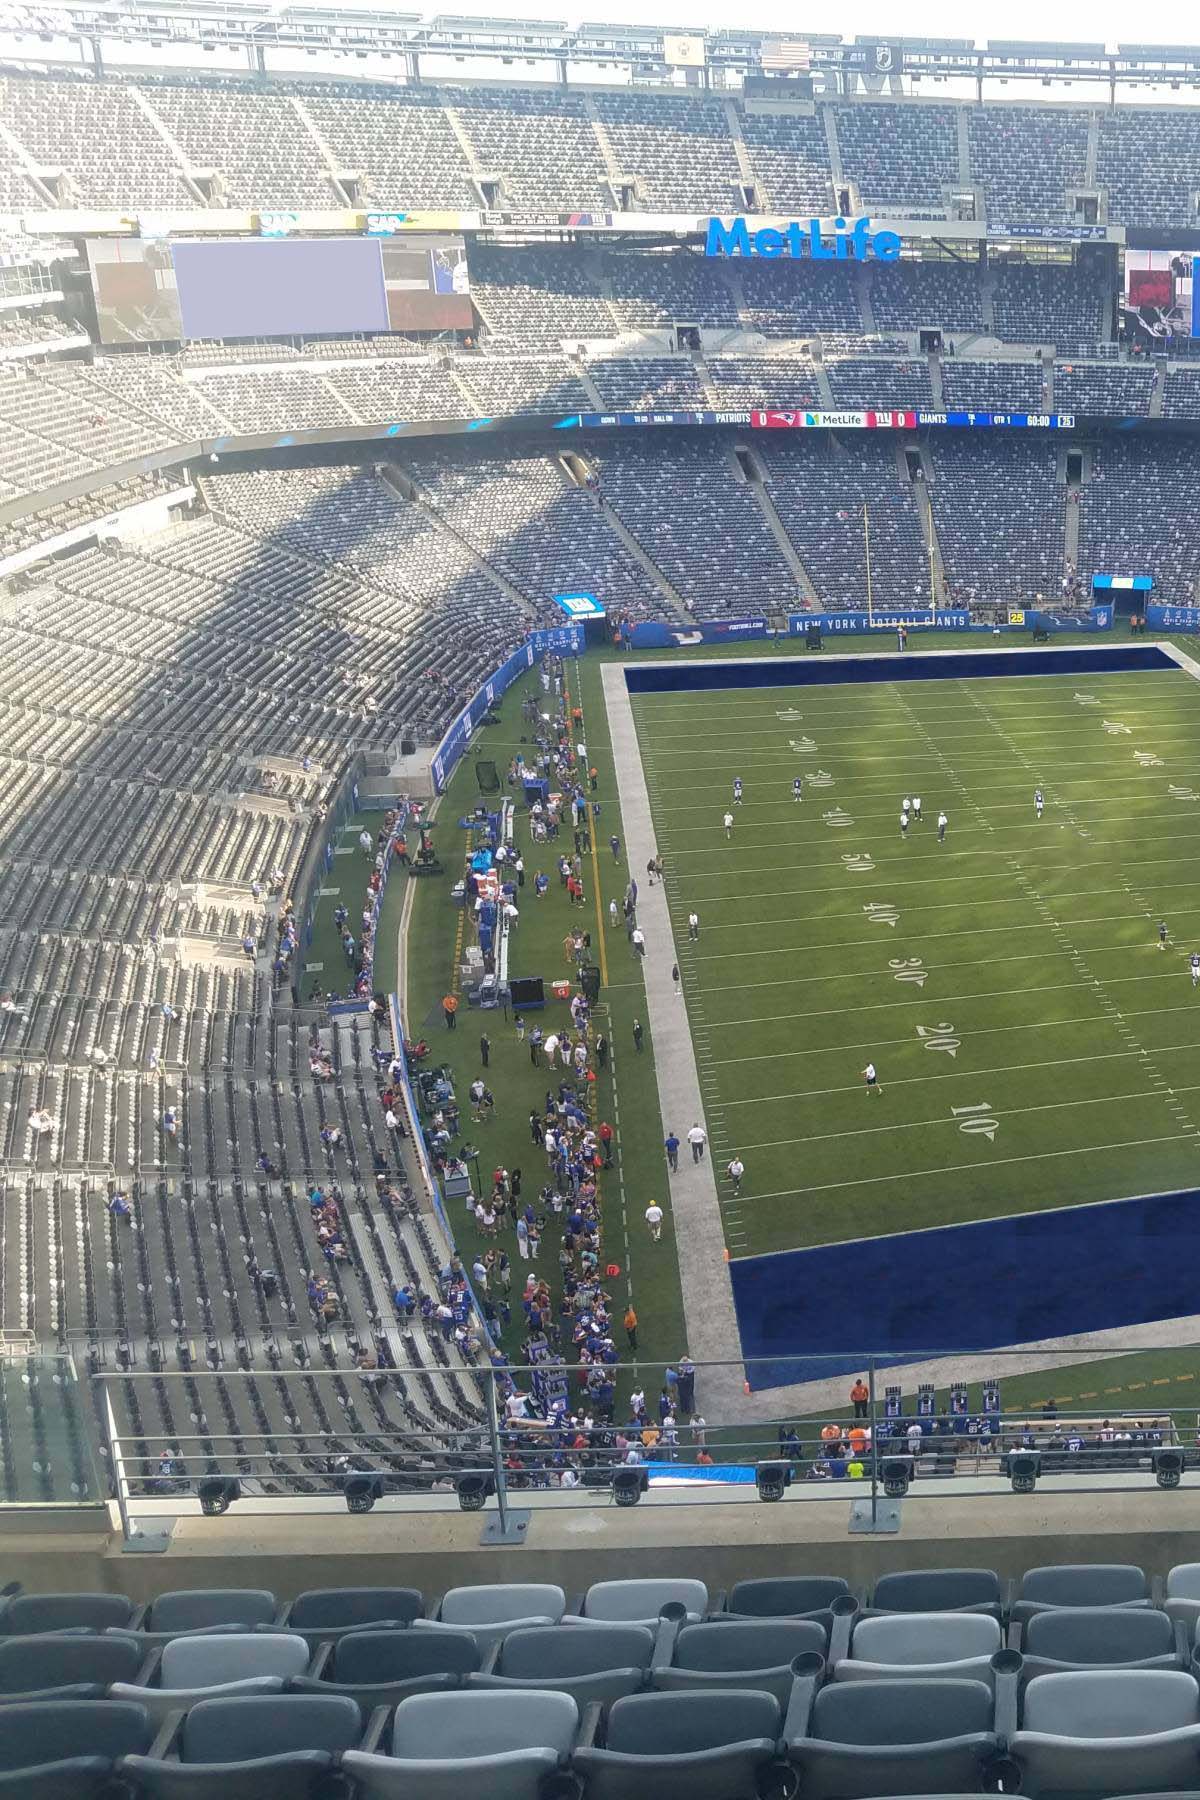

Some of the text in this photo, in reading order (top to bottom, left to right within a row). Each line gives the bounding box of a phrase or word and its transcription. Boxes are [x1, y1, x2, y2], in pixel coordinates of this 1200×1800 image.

[368, 214, 400, 234] SAP
[706, 216, 901, 261] MetLife
[716, 412, 767, 426] PATRIOTS 0
[823, 415, 861, 425] MetLife
[897, 413, 906, 427] 0
[919, 413, 947, 424] GIANTS
[1027, 416, 1050, 427] 60:00
[796, 616, 965, 631] NEW YORK FOOTBALL GANTS
[1010, 612, 1025, 624] 25
[1073, 692, 1101, 705] 10
[776, 708, 803, 721] 10
[1101, 721, 1132, 735] 20
[789, 738, 818, 752] 20
[1133, 752, 1165, 767] 30
[805, 771, 835, 787] 30
[1168, 786, 1200, 801] 40
[822, 810, 855, 827] 40
[841, 853, 876, 871] 50
[863, 902, 900, 923] 40
[888, 957, 928, 982] 30
[915, 1022, 961, 1051] 20
[950, 1102, 999, 1133] 10
